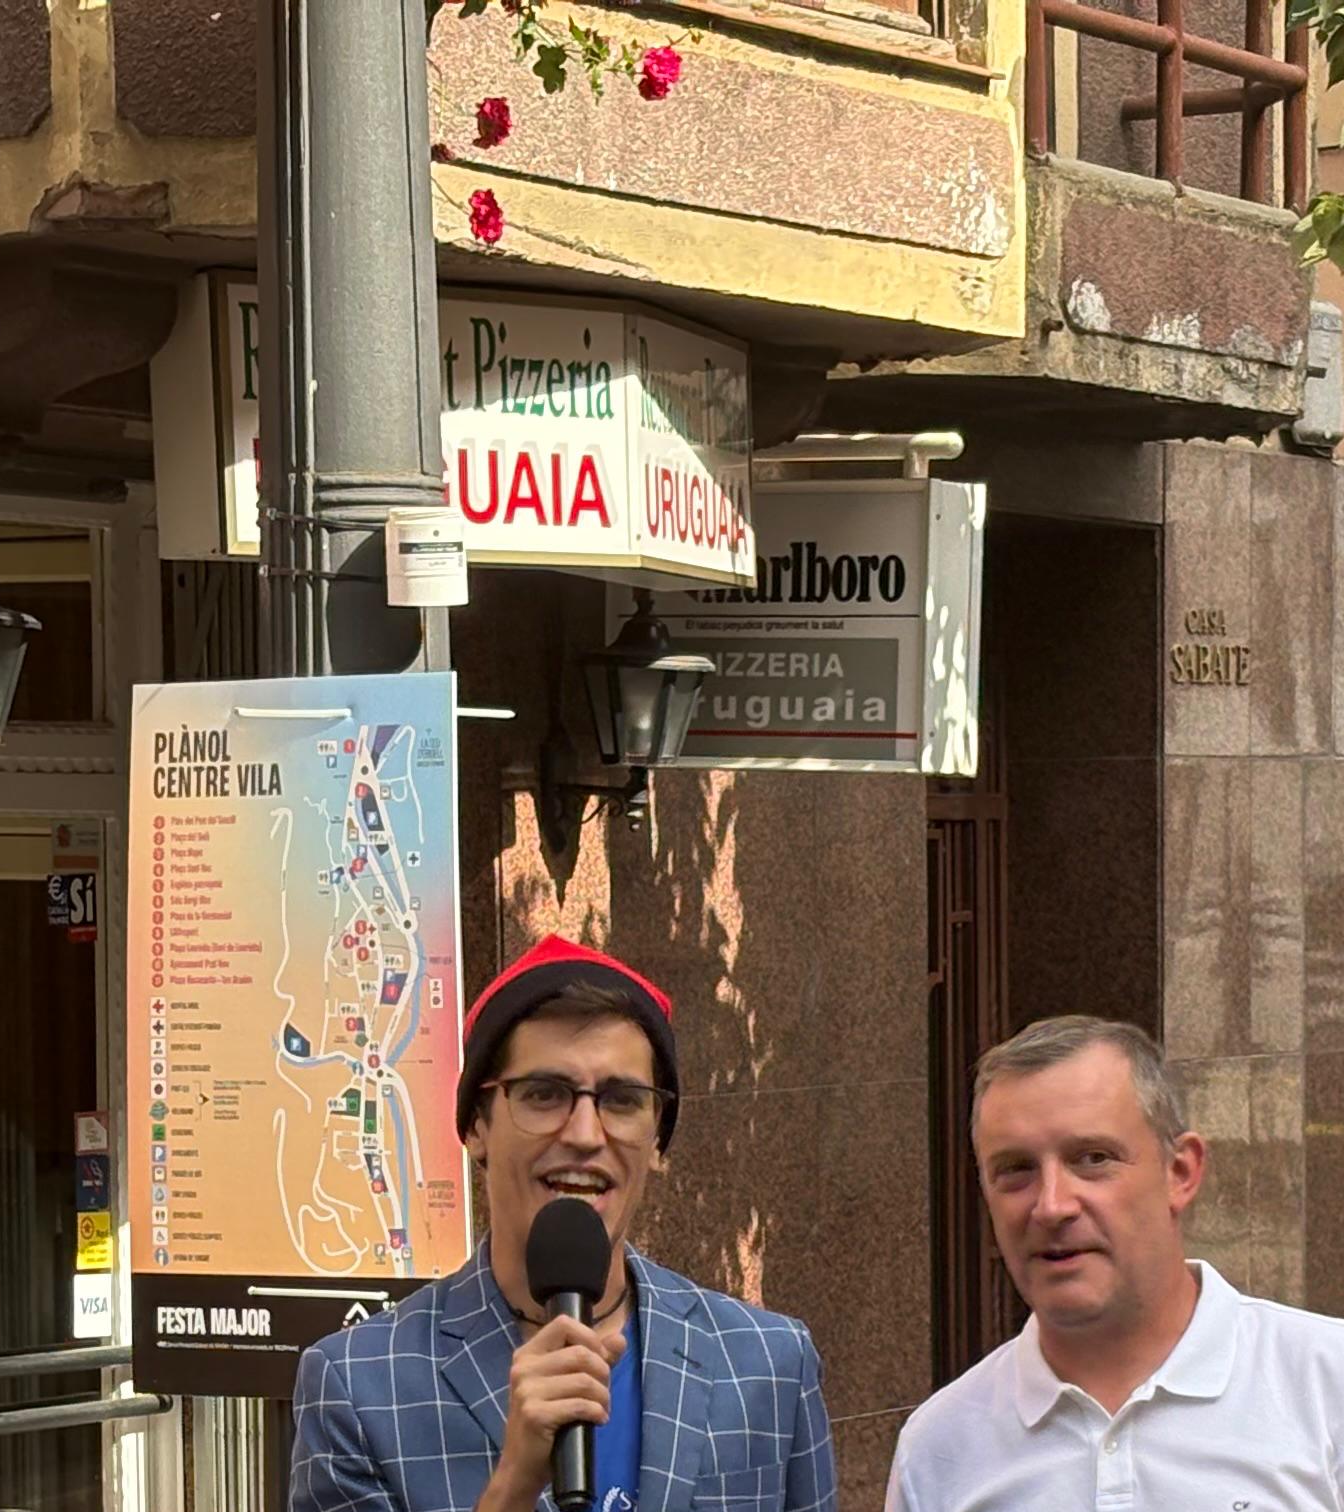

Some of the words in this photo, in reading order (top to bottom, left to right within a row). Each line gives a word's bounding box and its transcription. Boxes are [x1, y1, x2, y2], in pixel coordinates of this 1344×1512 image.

[470, 316, 615, 421] Pizzeria
[644, 462, 749, 555] URUGUAIA
[701, 541, 906, 604] arlboro
[1184, 608, 1227, 637] CASA
[716, 652, 845, 678] IZZERIA
[692, 688, 887, 729] ruguaia
[154, 723, 232, 765] PLÀNOL
[153, 764, 231, 799] CENTRE
[236, 762, 283, 797] VILA
[70, 875, 94, 925] Sí
[80, 1296, 109, 1315] VISA
[157, 1306, 207, 1336] FESTA
[210, 1307, 272, 1337] MAJOR
